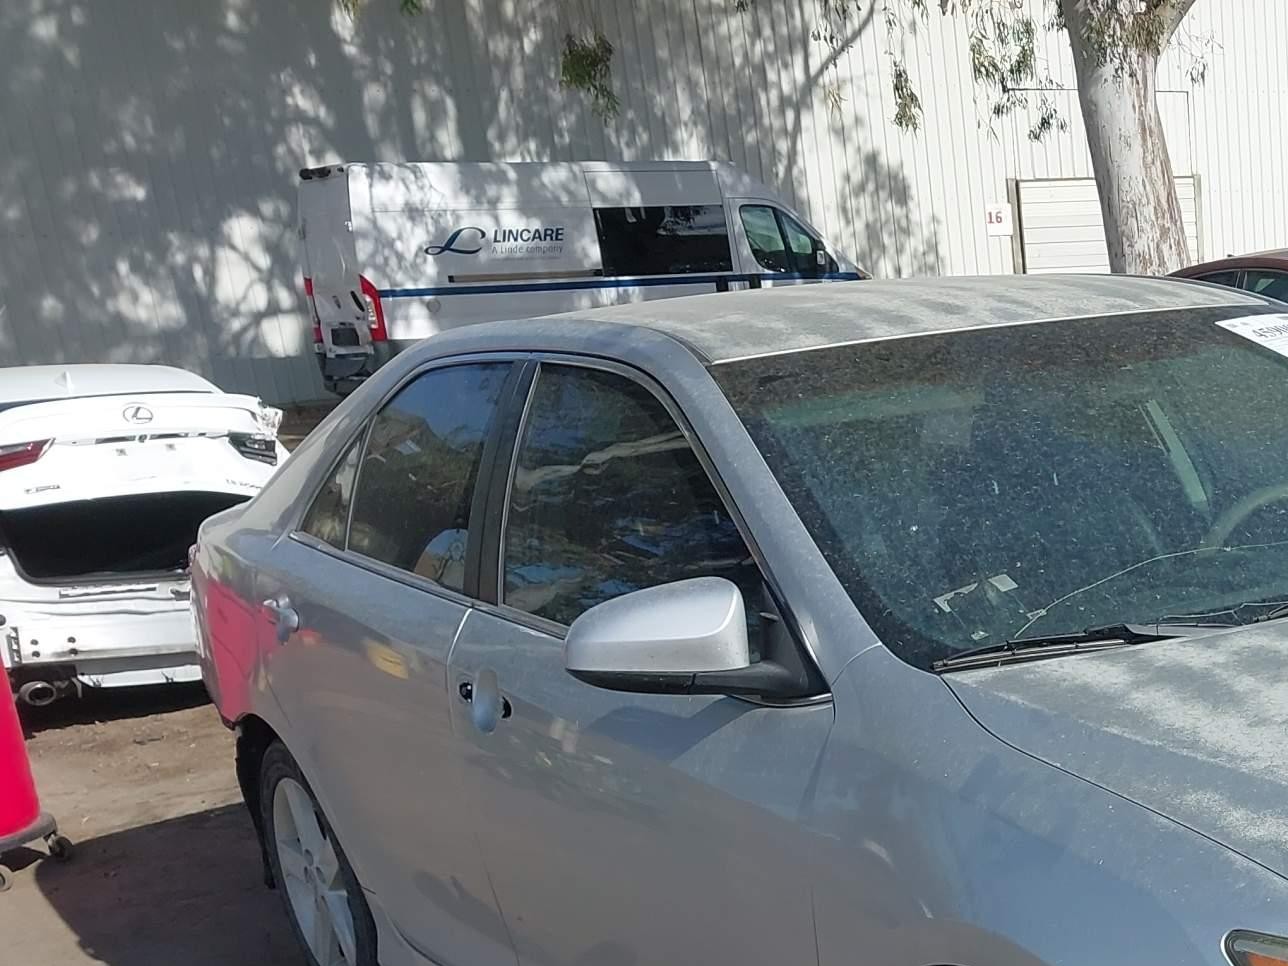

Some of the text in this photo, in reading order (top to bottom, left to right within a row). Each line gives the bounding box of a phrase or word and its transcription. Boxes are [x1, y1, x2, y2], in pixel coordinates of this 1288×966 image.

[987, 211, 1003, 224] 16
[493, 228, 565, 243] LINCARE
[492, 245, 563, 257] A Linde company
